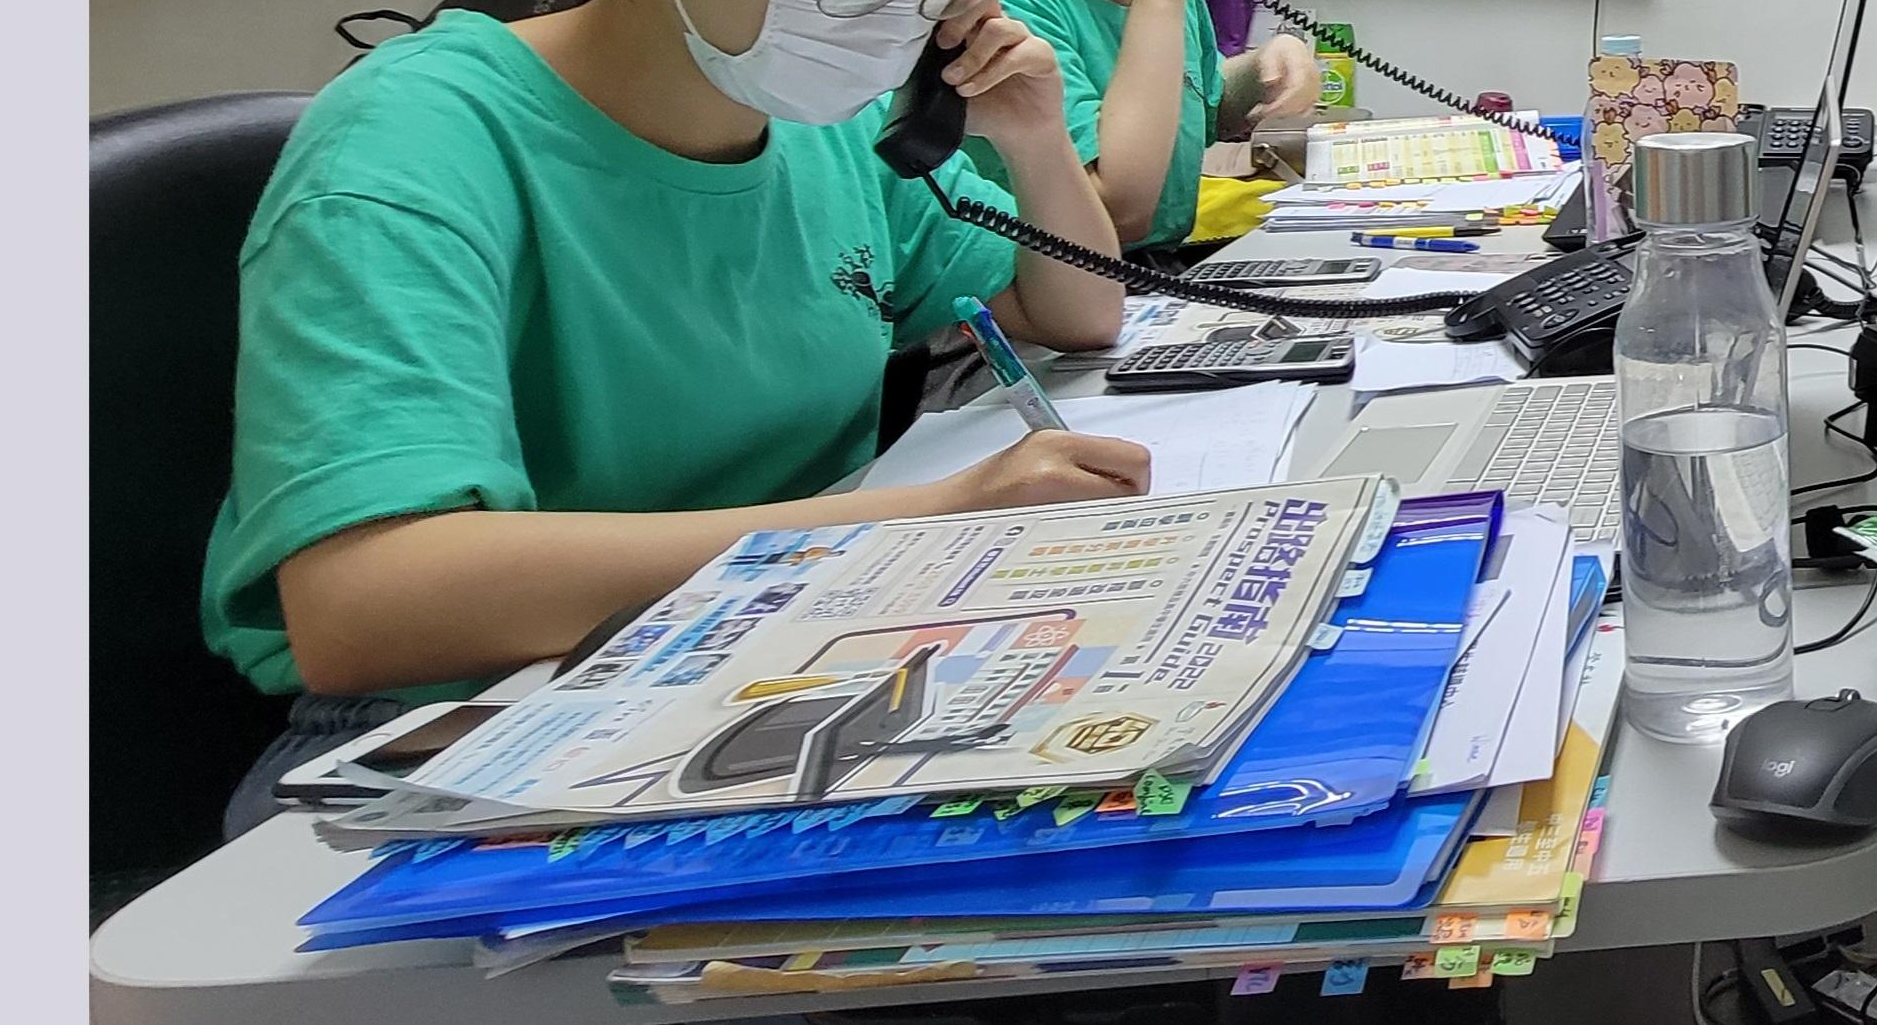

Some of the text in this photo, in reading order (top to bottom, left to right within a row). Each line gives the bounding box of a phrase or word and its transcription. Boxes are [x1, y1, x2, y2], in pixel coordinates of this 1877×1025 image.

[1202, 500, 1281, 608] Prospect
[1206, 498, 1329, 646] 出路指南
[1143, 613, 1214, 685] Guide
[1166, 641, 1224, 691] 2022
